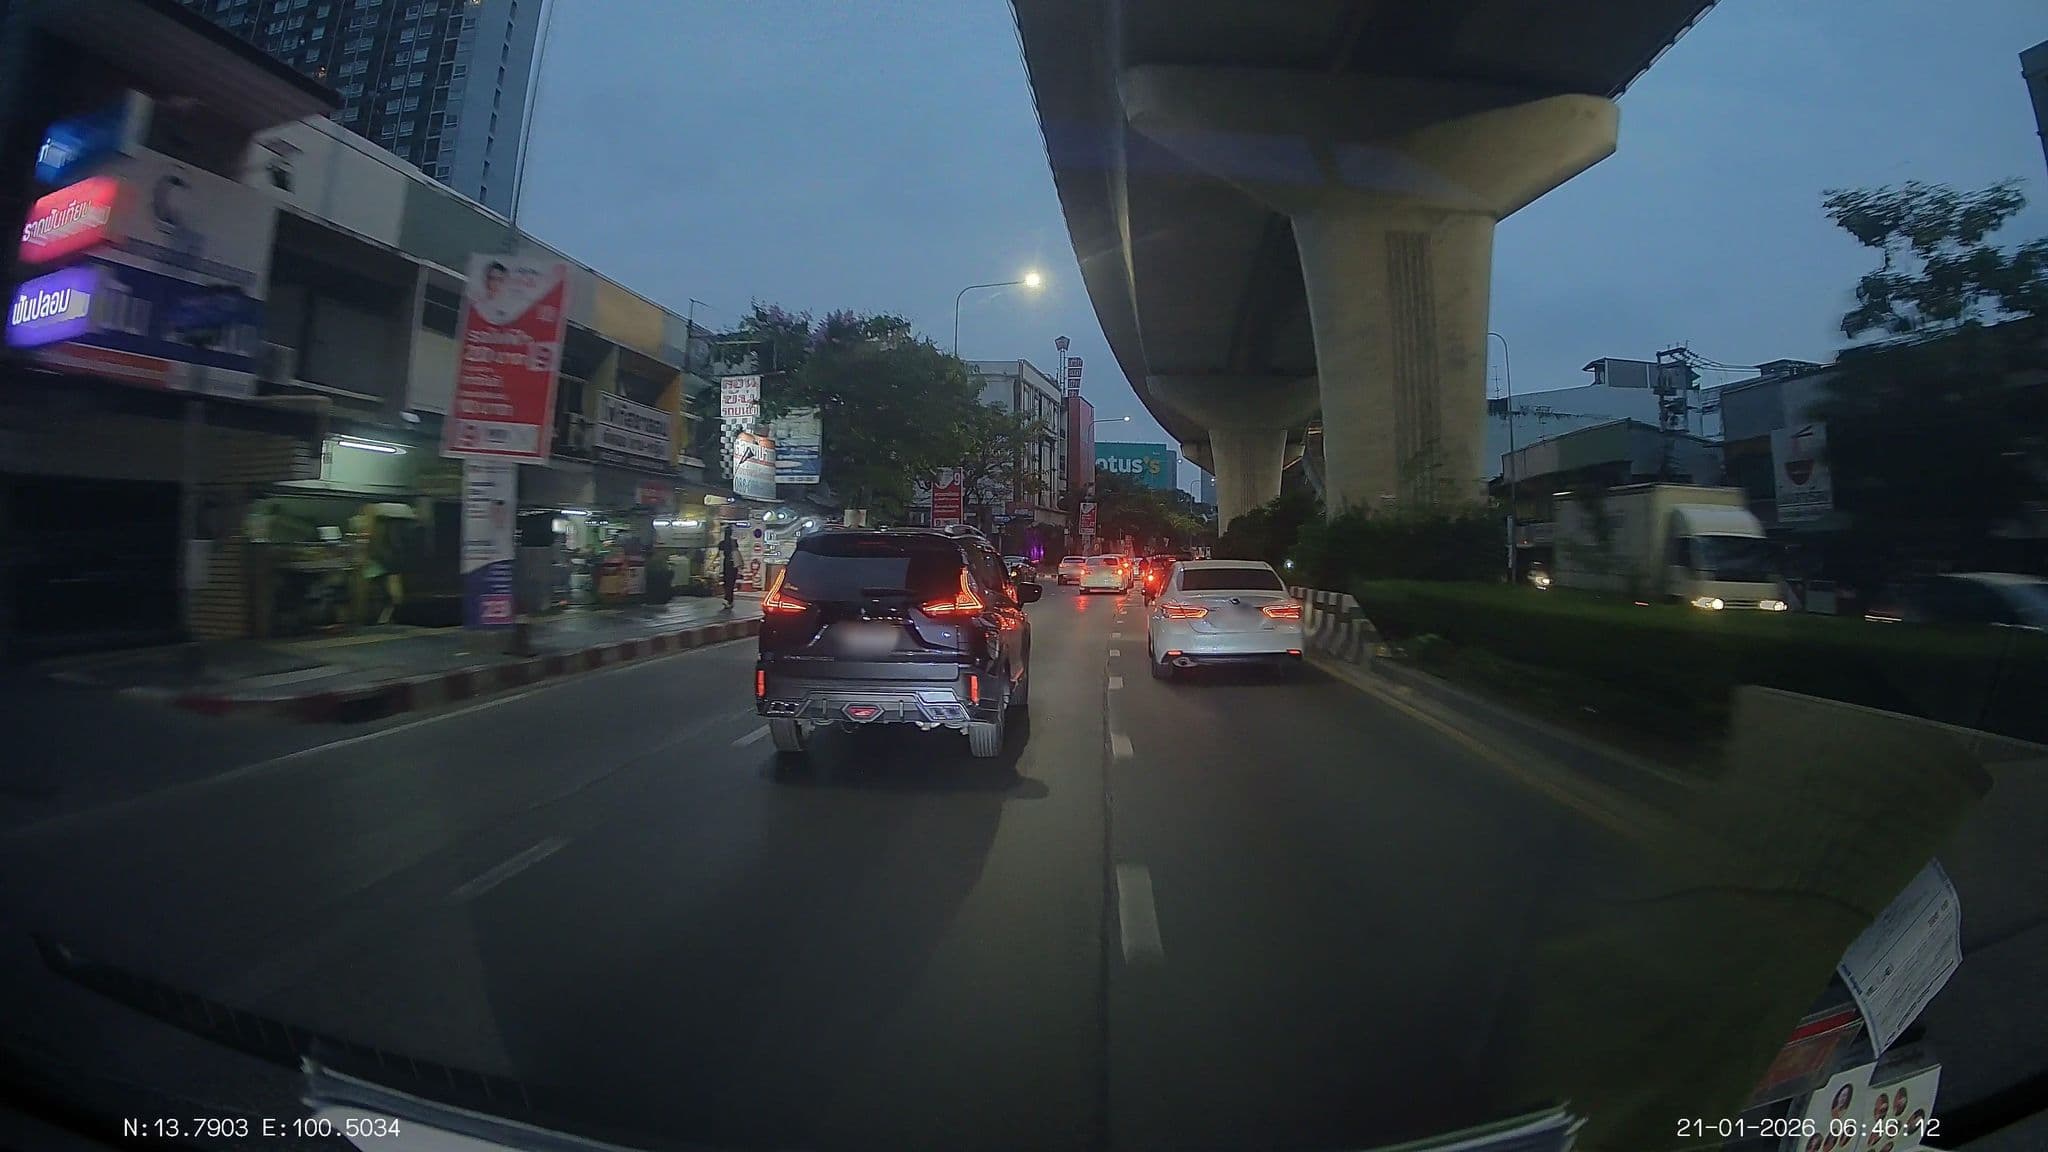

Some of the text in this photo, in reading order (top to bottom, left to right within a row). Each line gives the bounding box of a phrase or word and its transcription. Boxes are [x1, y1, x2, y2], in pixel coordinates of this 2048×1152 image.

[12, 288, 71, 325] ฟันปลอม
[1095, 456, 1160, 473] otus's
